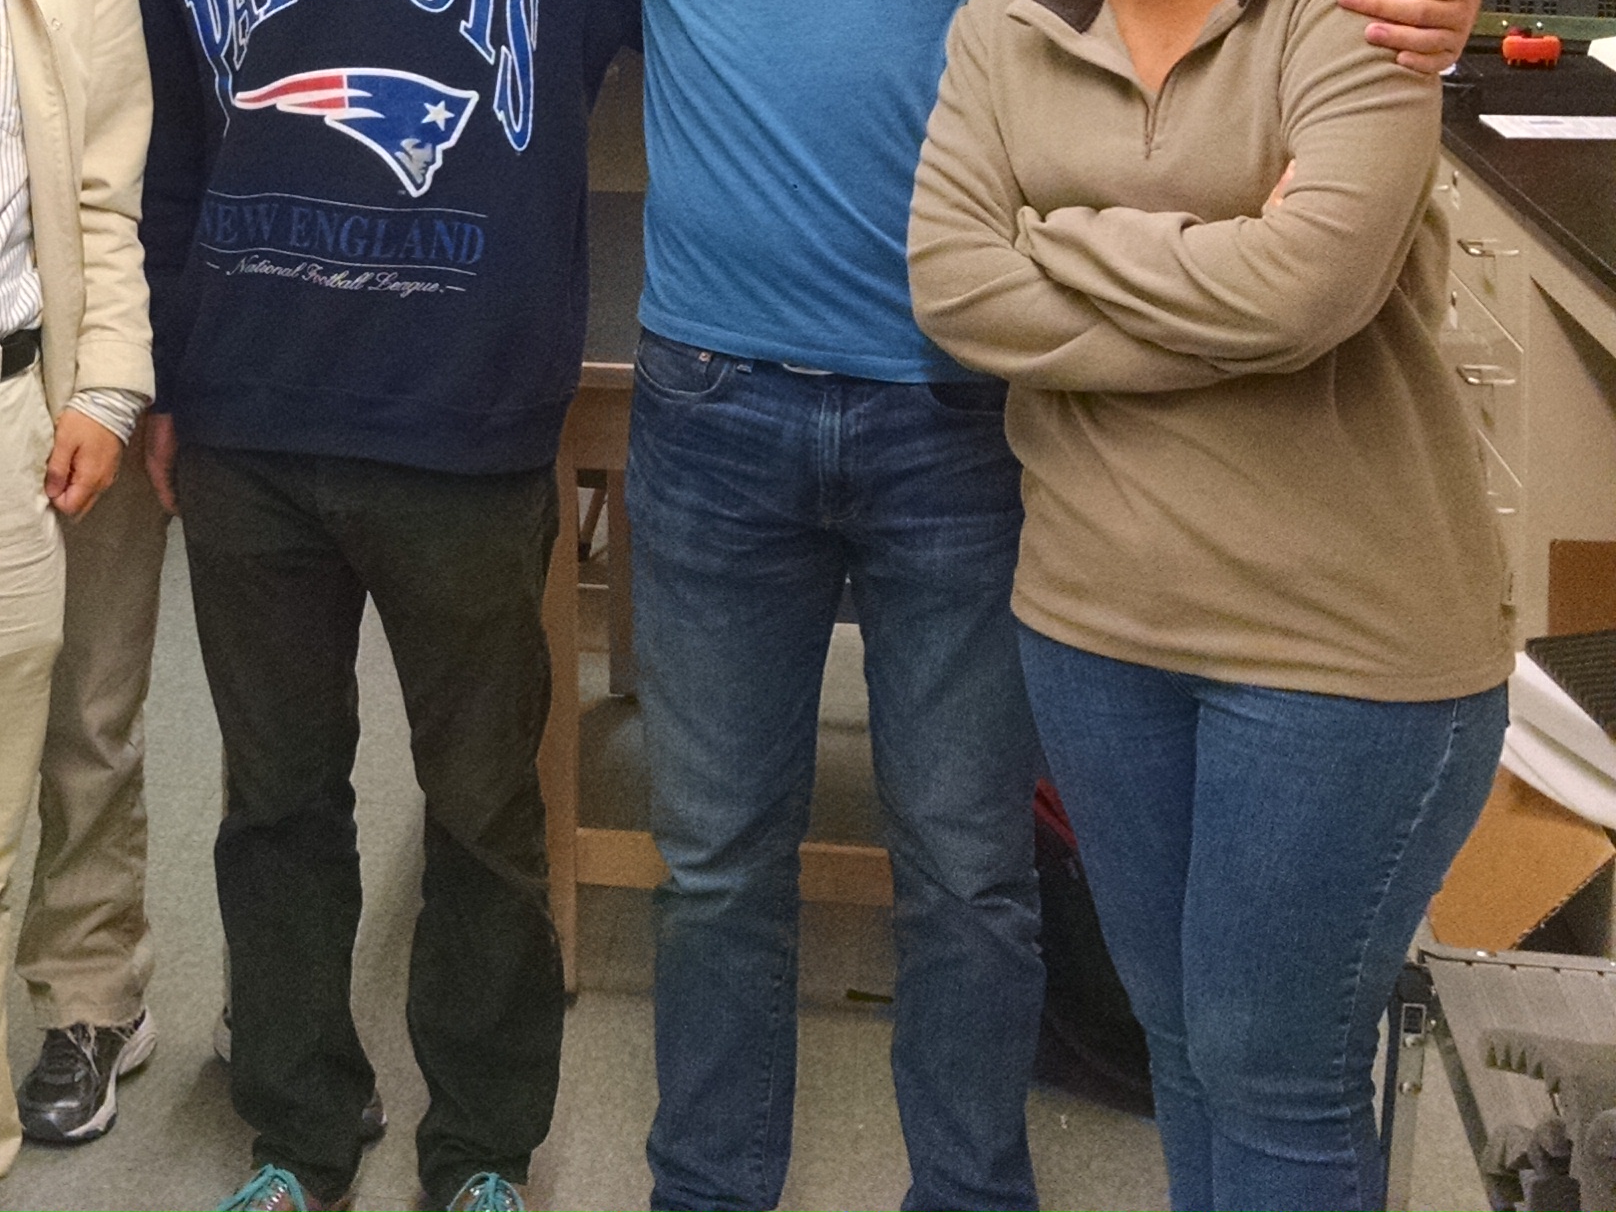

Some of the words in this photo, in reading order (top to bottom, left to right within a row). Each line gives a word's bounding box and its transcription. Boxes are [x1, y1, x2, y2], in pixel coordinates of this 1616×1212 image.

[288, 205, 484, 266] ENGLAND
[226, 254, 308, 278] National
[301, 262, 375, 291] Football
